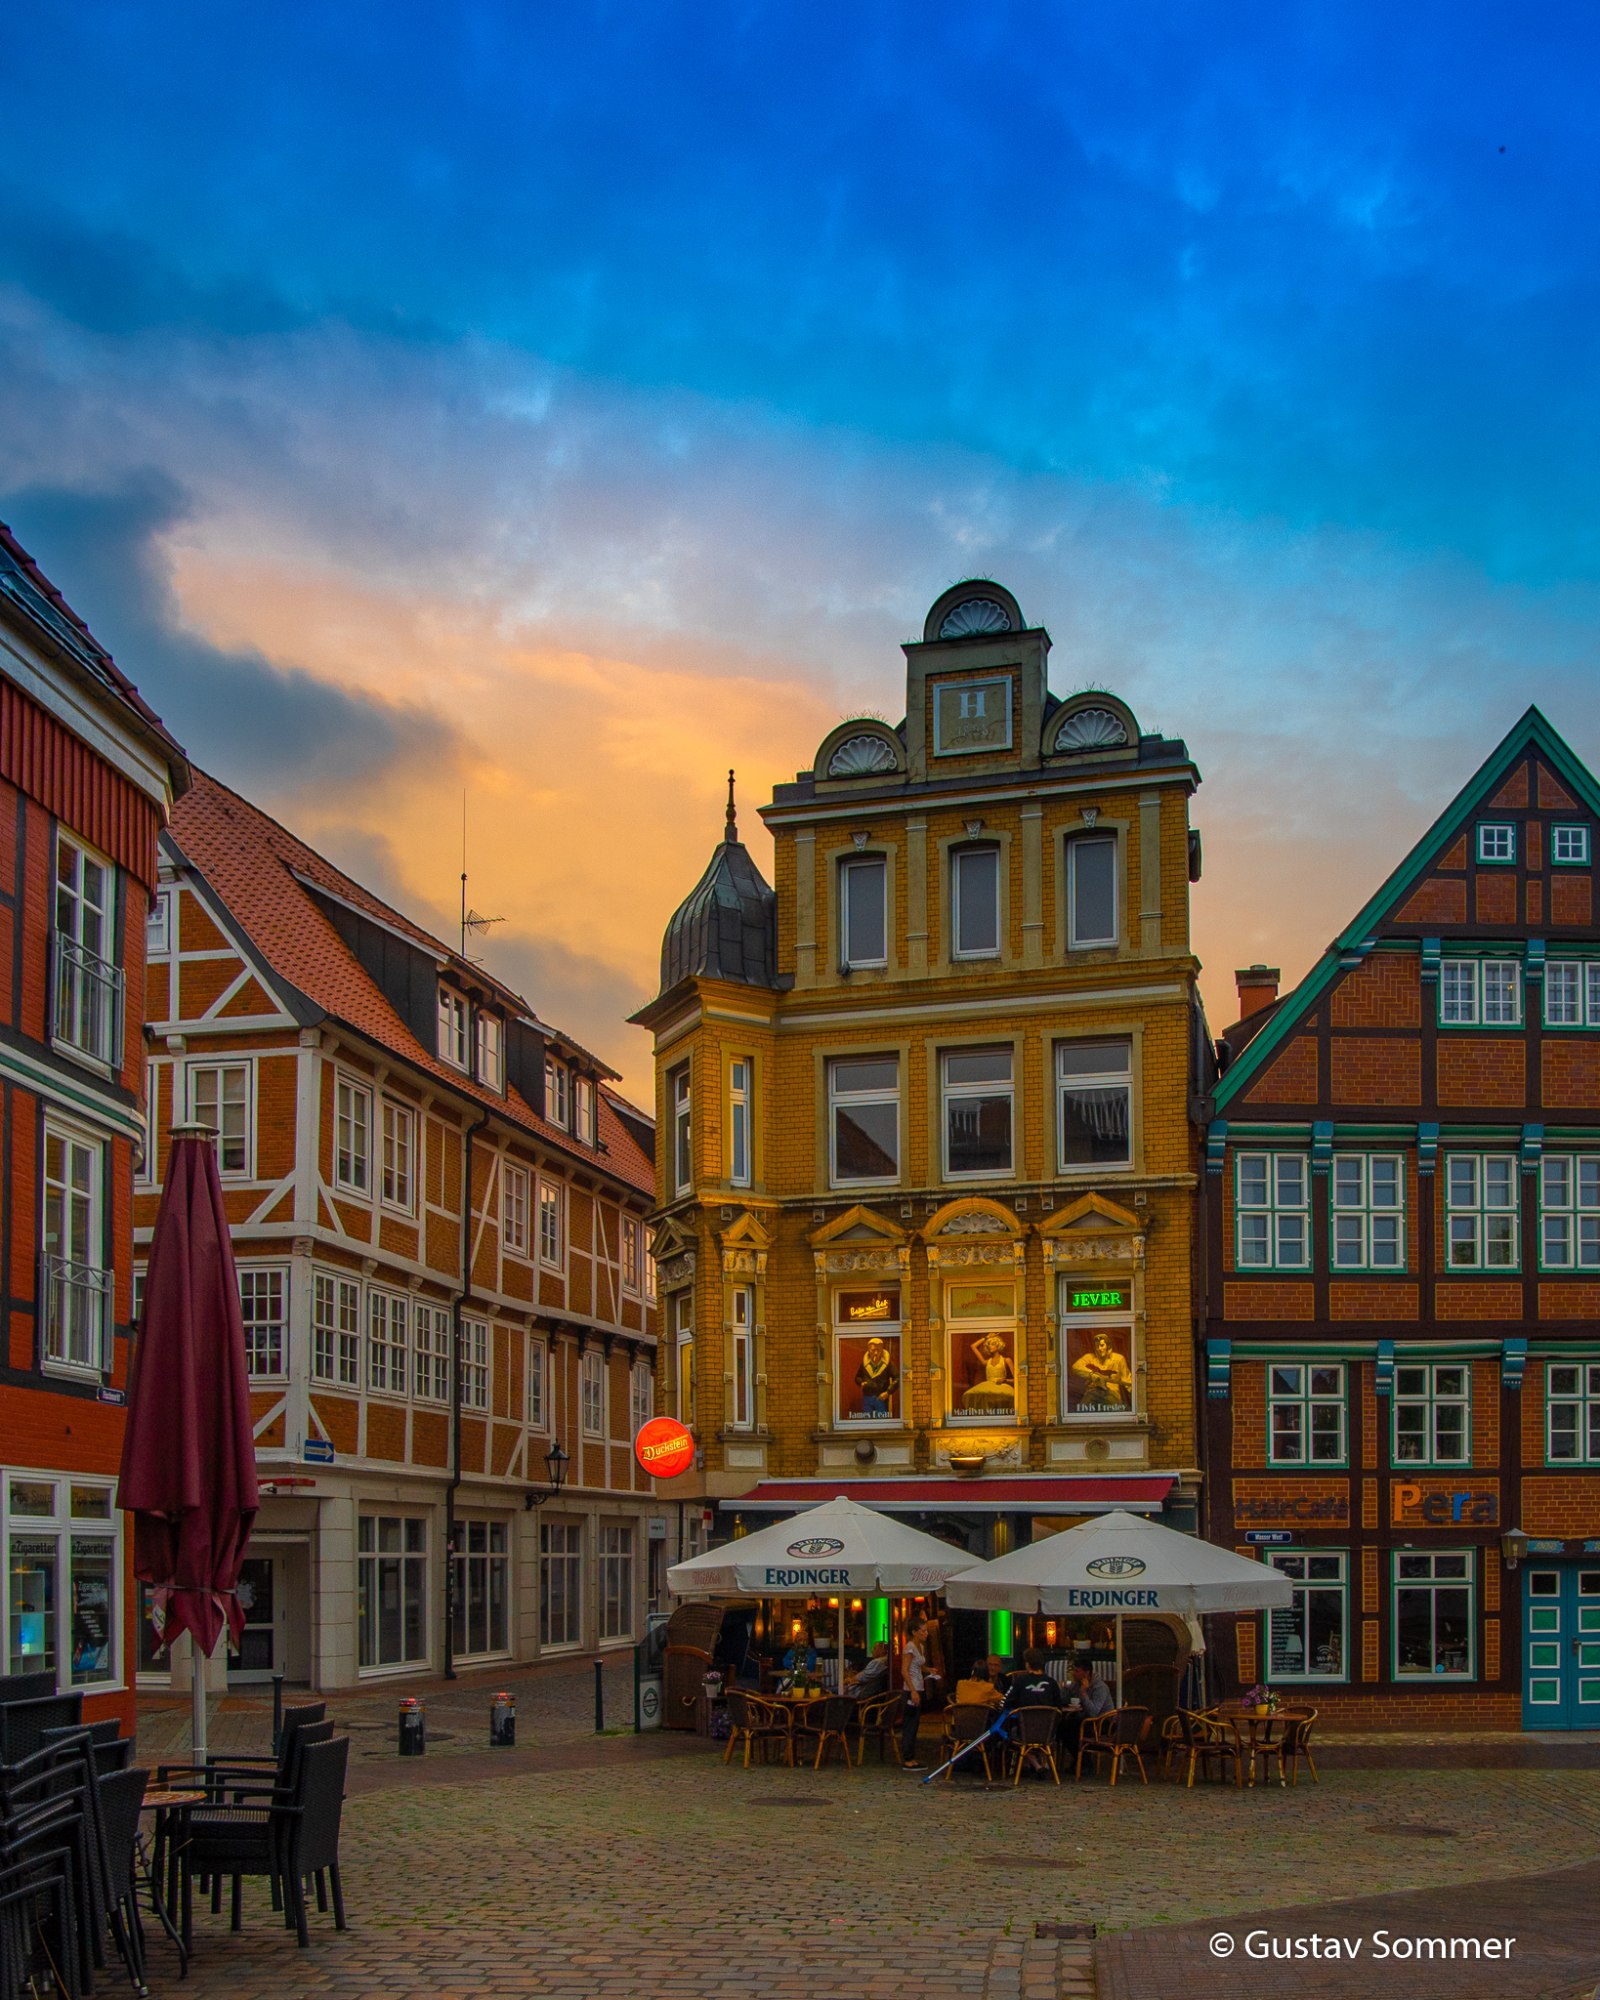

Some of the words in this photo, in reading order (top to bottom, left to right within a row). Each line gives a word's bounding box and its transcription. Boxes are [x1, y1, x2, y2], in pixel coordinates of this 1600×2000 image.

[959, 691, 986, 719] H
[1072, 1292, 1122, 1307] JEVER
[848, 1411, 871, 1419] James
[872, 1410, 893, 1419] Dean
[953, 1407, 984, 1416] Marilyn
[985, 1407, 1015, 1415] Monroe
[1076, 1403, 1096, 1412] Elvis
[1097, 1403, 1126, 1412] Presley
[642, 1438, 688, 1461] Duckstein
[1393, 1484, 1497, 1522] Pera
[765, 1568, 852, 1588] ERDINGER
[1069, 1589, 1159, 1608] ERDINGER
